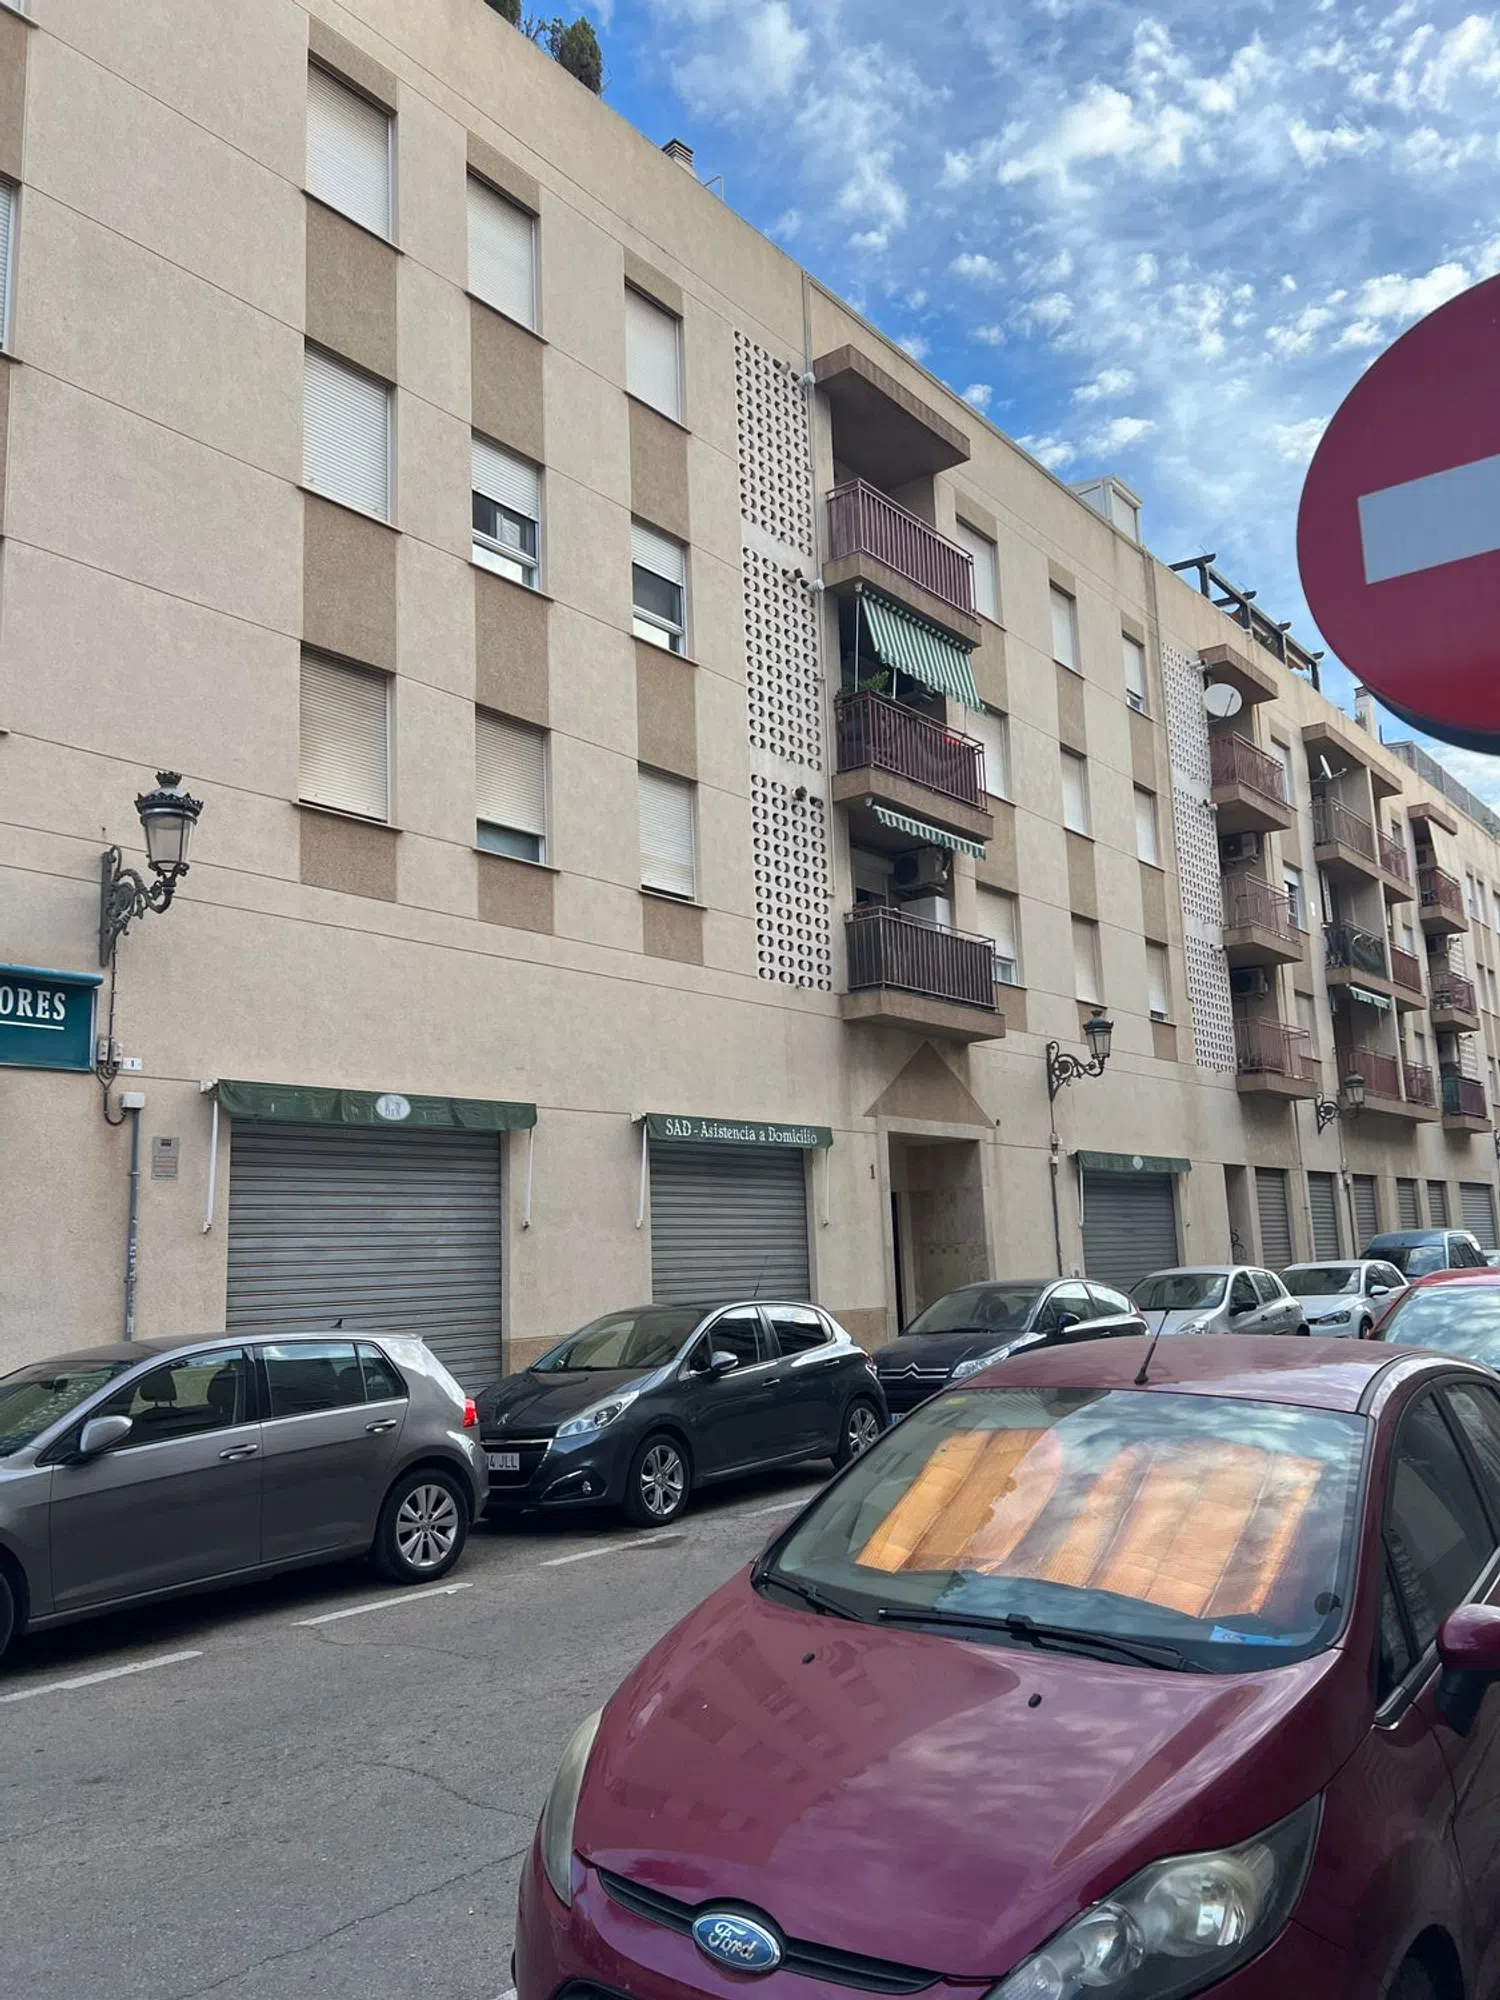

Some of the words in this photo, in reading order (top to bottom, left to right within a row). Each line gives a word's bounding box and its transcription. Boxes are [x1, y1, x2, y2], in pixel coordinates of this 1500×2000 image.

[0, 986, 65, 1021] ORES
[665, 1118, 692, 1136] SAD
[700, 1121, 756, 1141] Asistencia
[759, 1132, 766, 1142] a
[768, 1126, 818, 1145] Domicilio
[869, 1163, 876, 1180] 1
[708, 1921, 758, 1961] Ford
